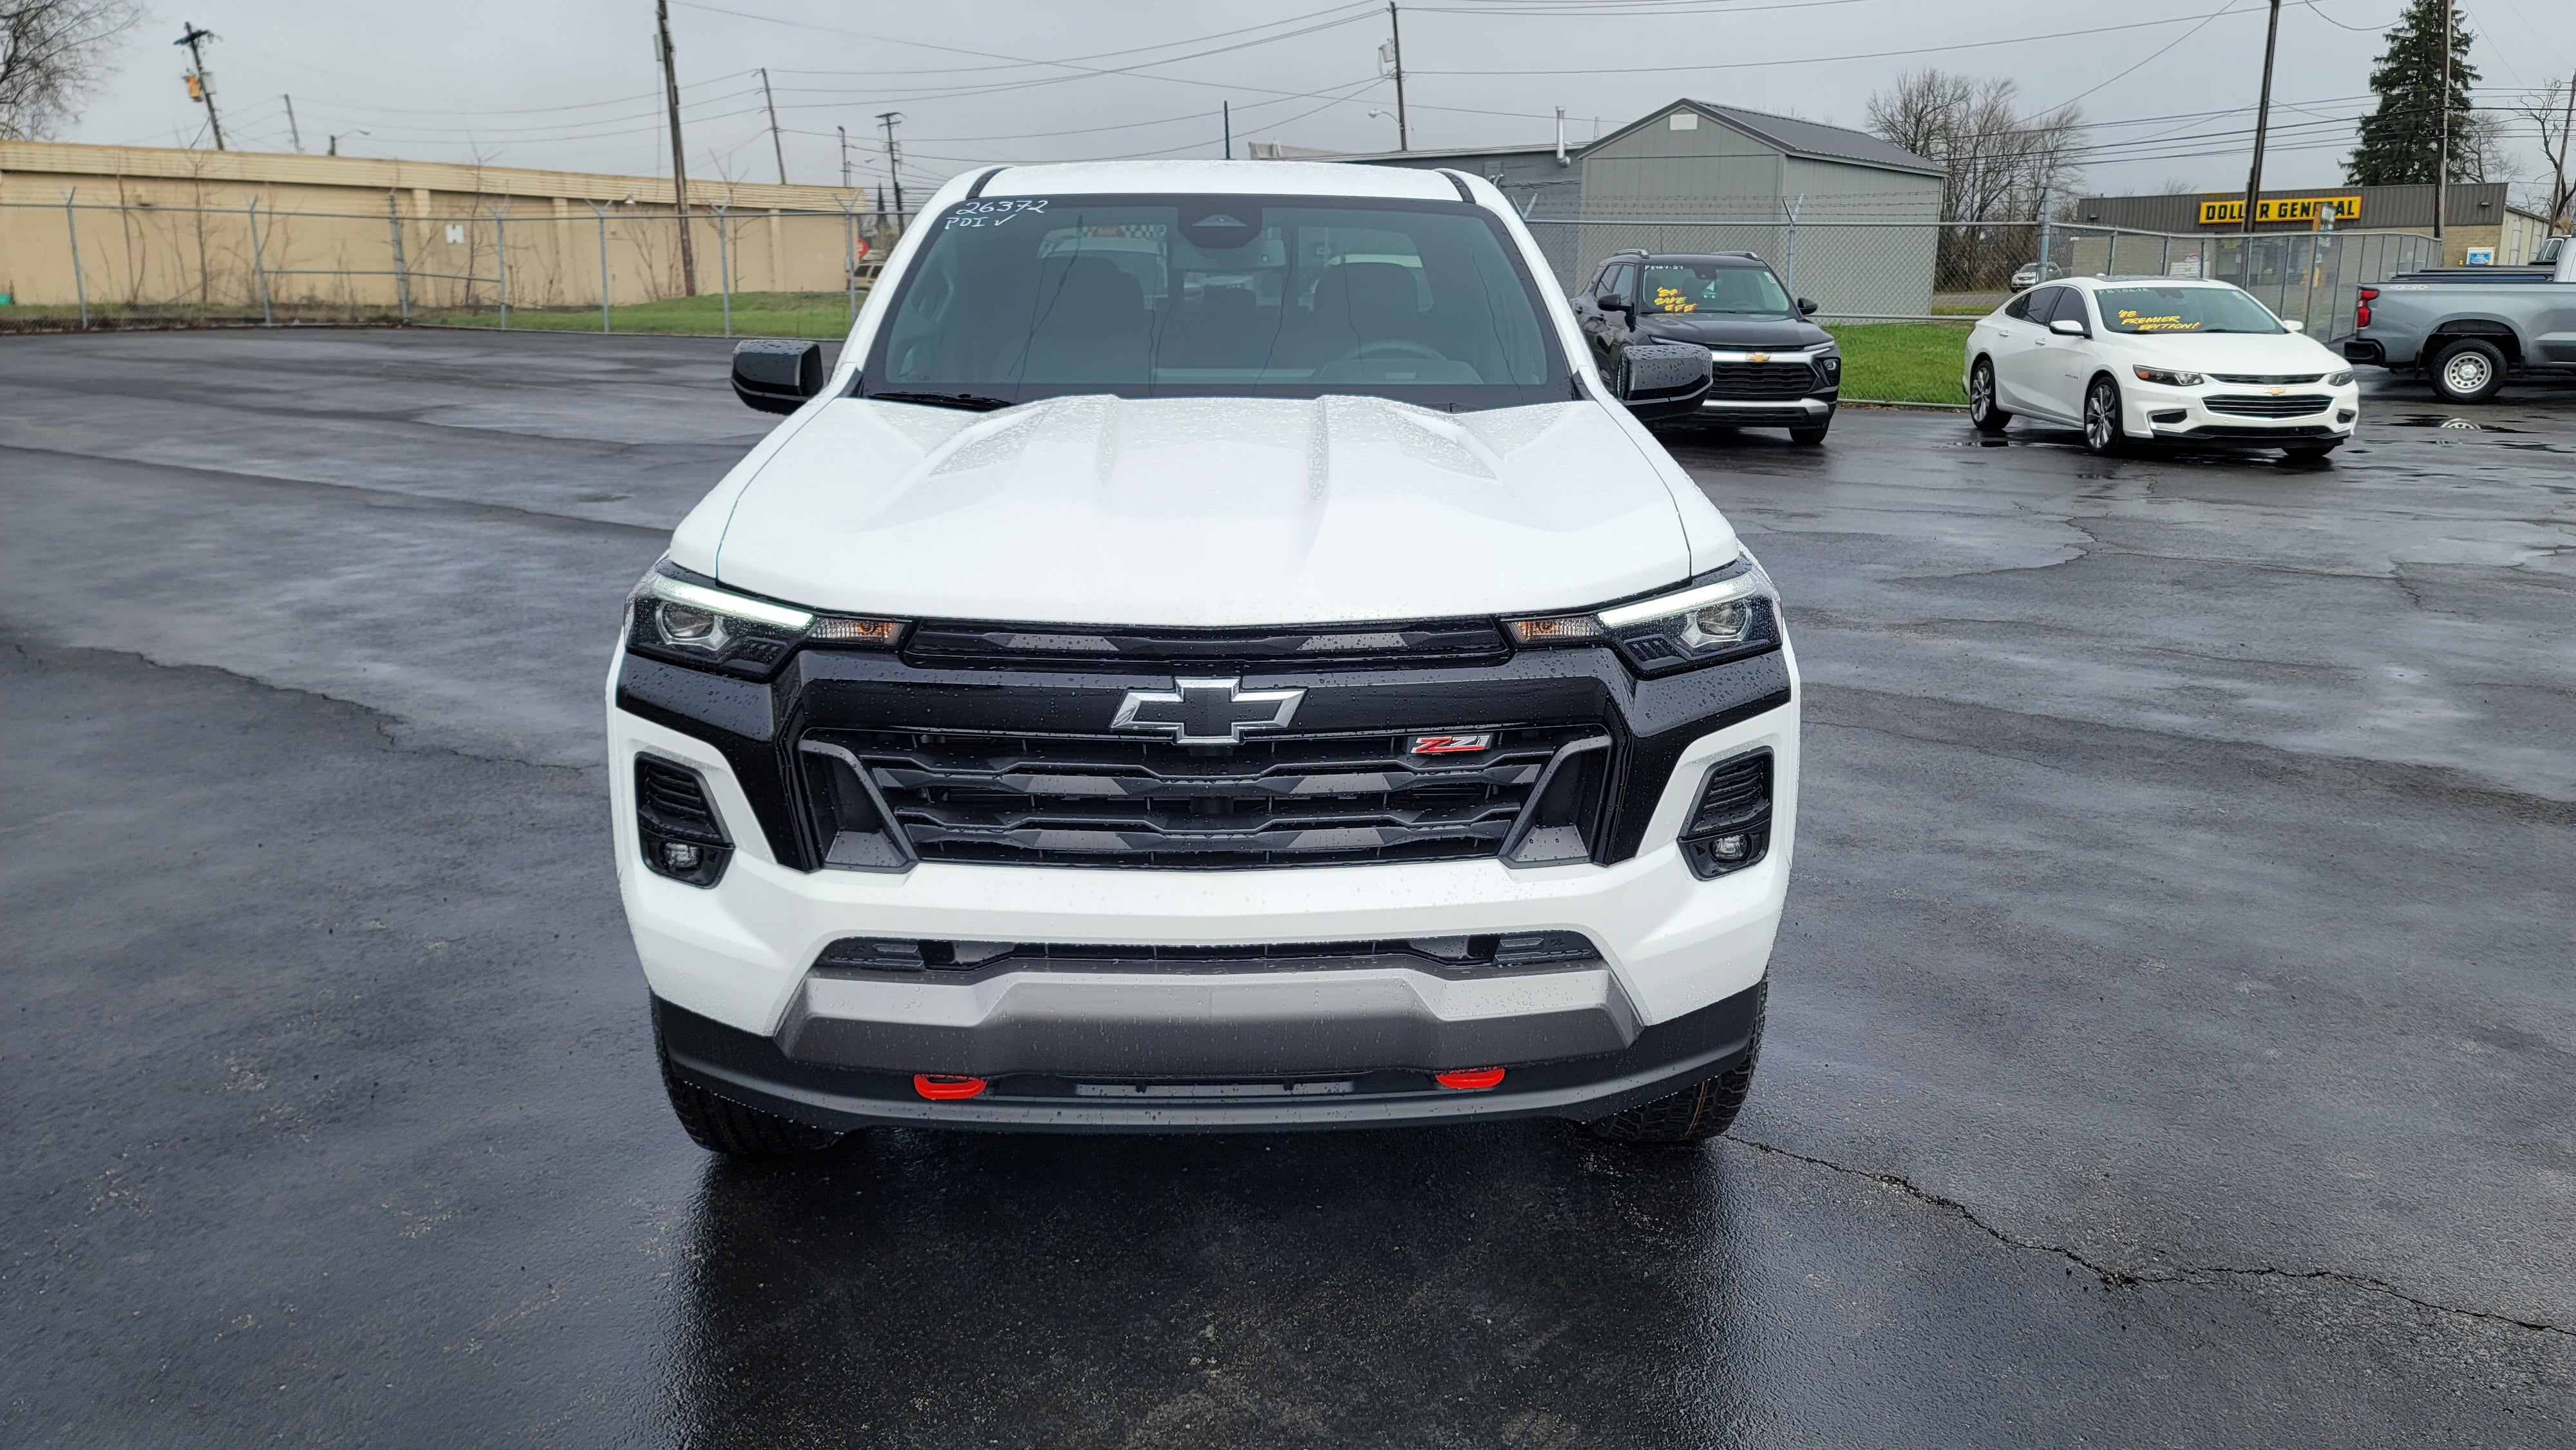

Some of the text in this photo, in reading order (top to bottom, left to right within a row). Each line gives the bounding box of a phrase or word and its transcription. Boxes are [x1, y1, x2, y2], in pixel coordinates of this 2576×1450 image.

[956, 200, 1048, 214] 26372
[2206, 203, 2269, 220] DOLLR
[945, 217, 989, 229] PDI
[1654, 297, 1687, 305] SAVE
[2121, 315, 2181, 325] PREMIER
[1410, 735, 1490, 754] Z71
